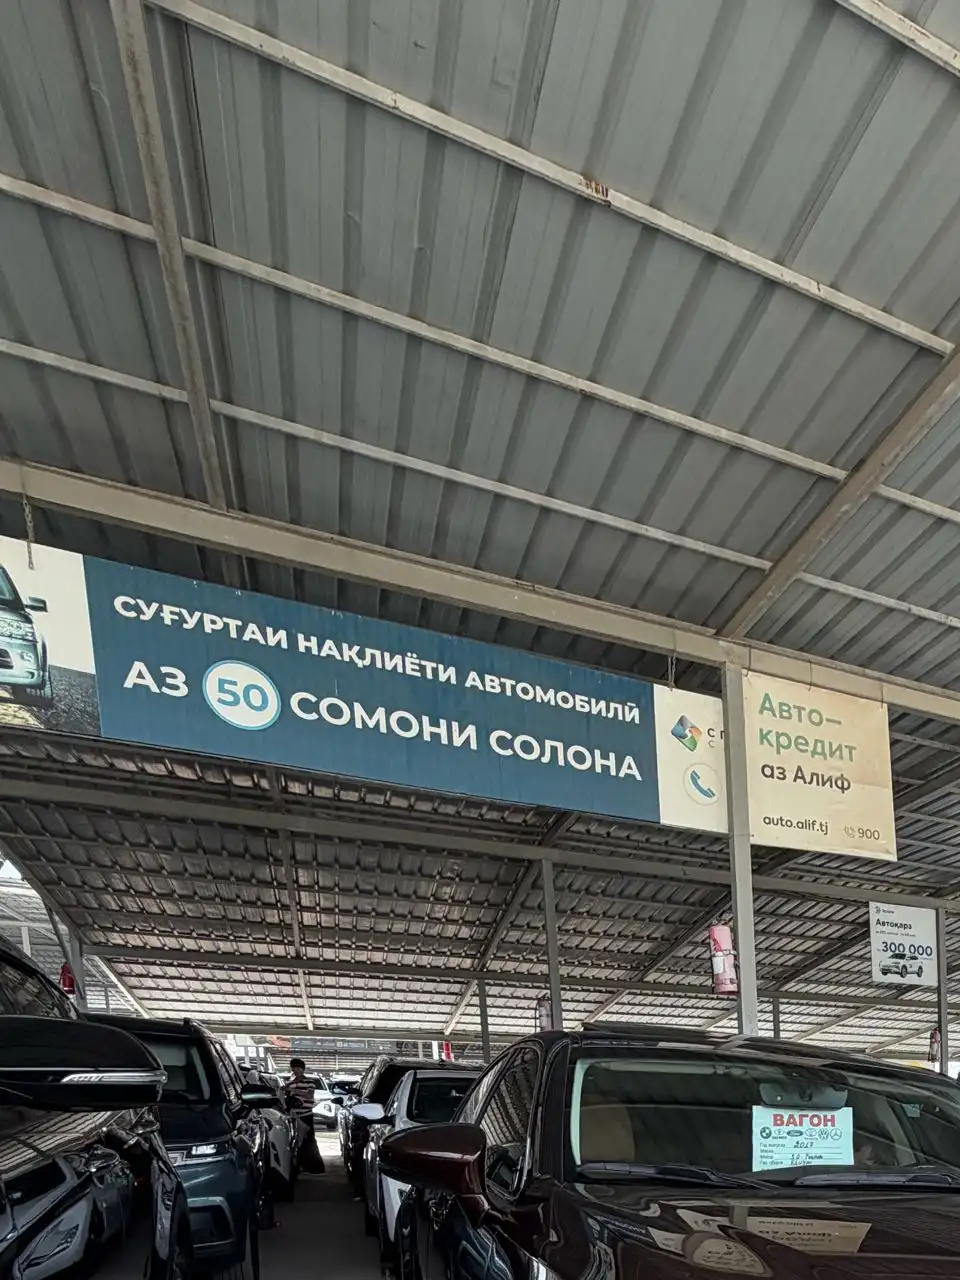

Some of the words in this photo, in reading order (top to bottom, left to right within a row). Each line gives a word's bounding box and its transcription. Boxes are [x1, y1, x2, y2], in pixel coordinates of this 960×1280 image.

[113, 595, 288, 649] СУҒУРТАИ
[297, 633, 457, 685] НАҚЛИЁТИ
[464, 671, 641, 724] АВТОМОБИЛӢ
[123, 661, 189, 697] АЗ
[216, 676, 269, 712] 50
[290, 691, 478, 750] СОМОНИ
[489, 730, 643, 781] СОЛОНА
[759, 728, 857, 763] кредит
[760, 763, 787, 781] аз
[792, 768, 851, 794] Алиф
[763, 815, 829, 836] auto.alif.tj
[857, 827, 880, 841] 900
[881, 941, 906, 953] 300
[908, 944, 933, 957] 000
[772, 1113, 836, 1127] ВАГОН
